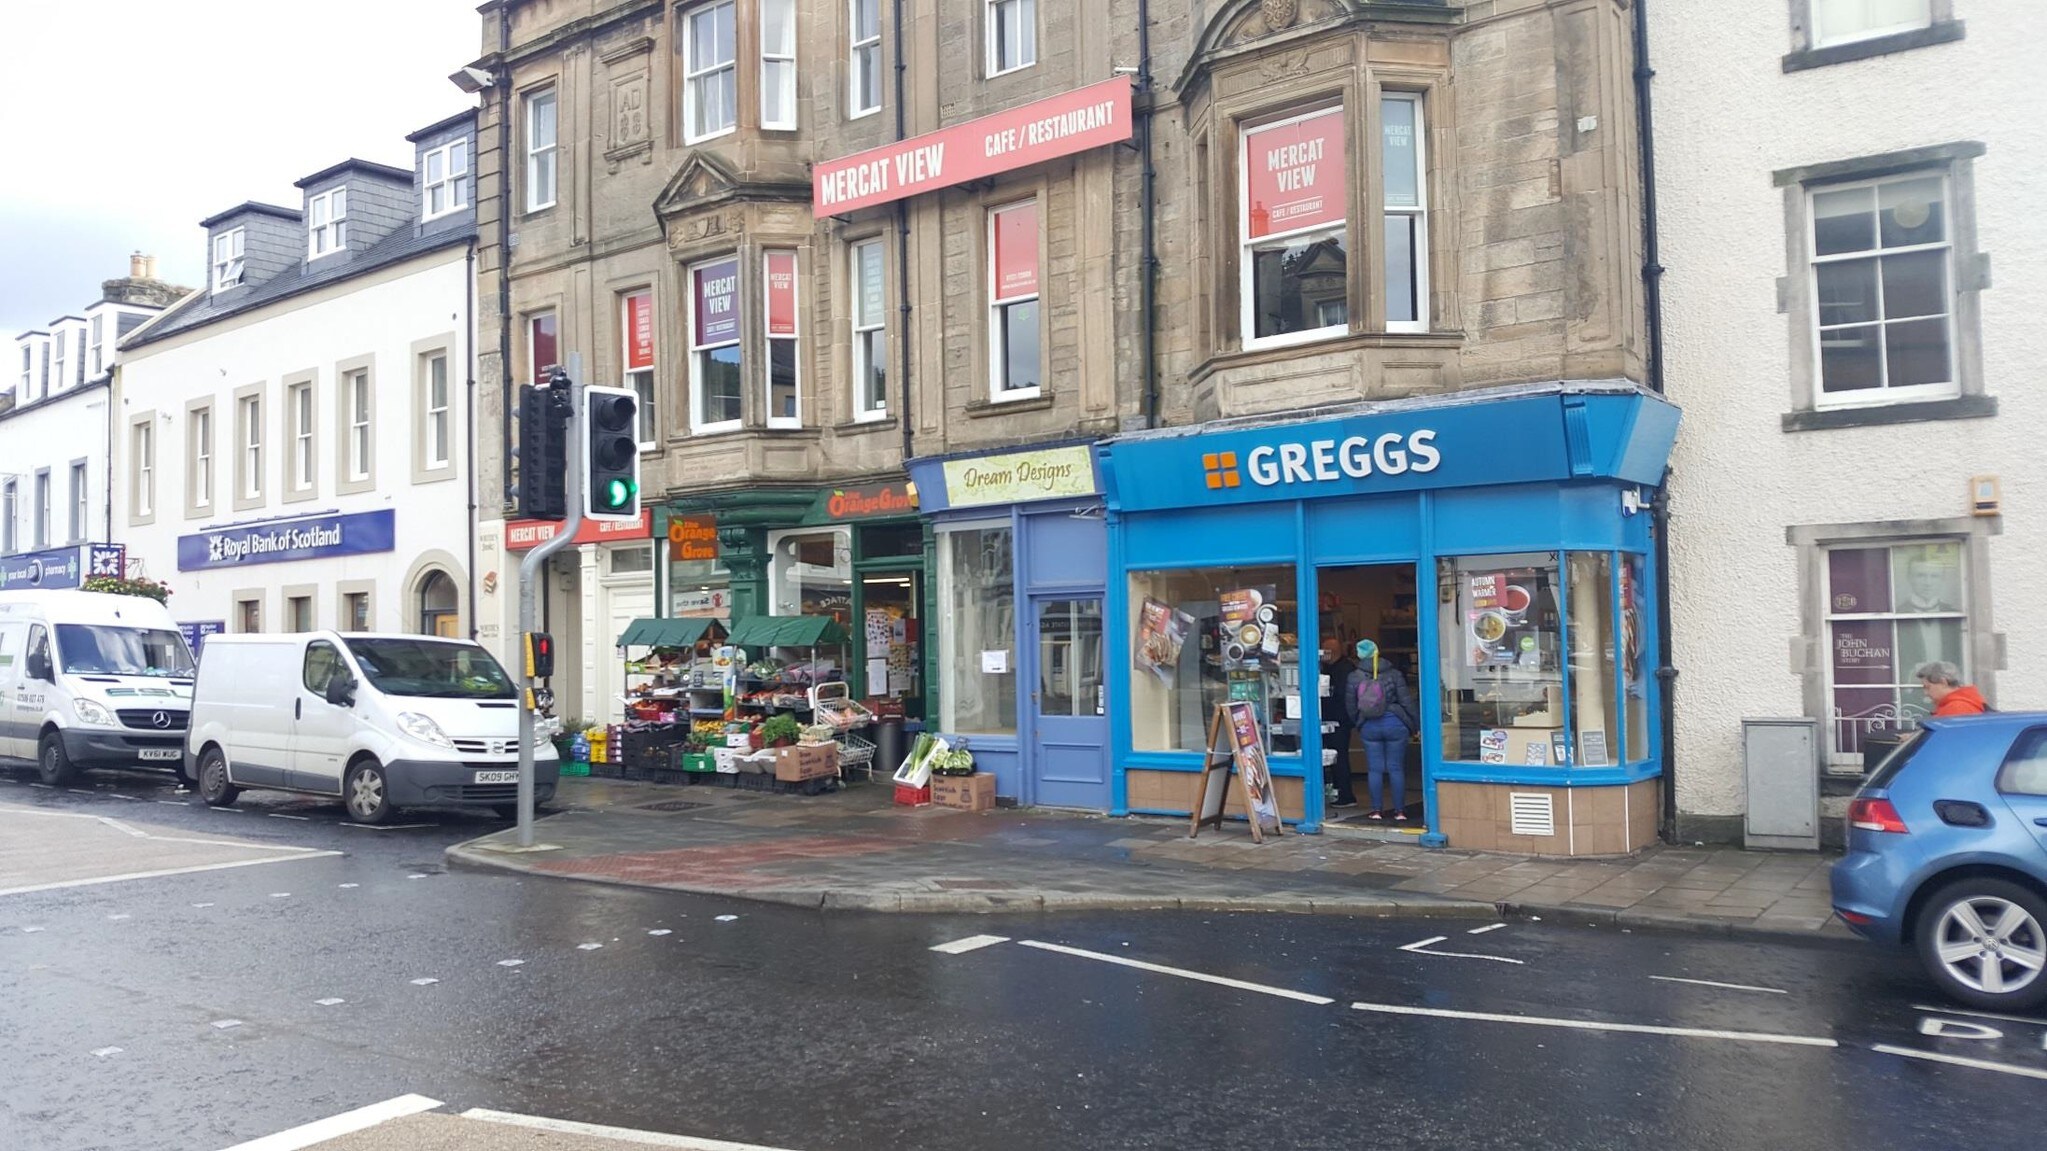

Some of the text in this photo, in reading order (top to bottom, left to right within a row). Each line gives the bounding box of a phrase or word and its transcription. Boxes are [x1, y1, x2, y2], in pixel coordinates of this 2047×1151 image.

[985, 128, 1016, 158] CAFE
[1028, 100, 1114, 145] RESTAURANT
[1268, 137, 1324, 171] MERCAT
[821, 142, 944, 205] MERCAT VIEW
[1276, 163, 1316, 193] VIEW
[703, 275, 736, 299] MERCAT
[709, 294, 731, 315] VIEW
[1247, 429, 1441, 486] GREGGS
[963, 461, 1071, 491] Dream Designs
[224, 523, 340, 560] Royal Bank of Scotland
[510, 527, 536, 542] MERCAT
[670, 523, 716, 543] Orange
[682, 541, 715, 559] Grove
[1472, 576, 1496, 587] AUTUMN
[1836, 639, 1868, 650] JOHN
[1841, 648, 1890, 658] BUCHAN
[479, 773, 502, 782] SK09
